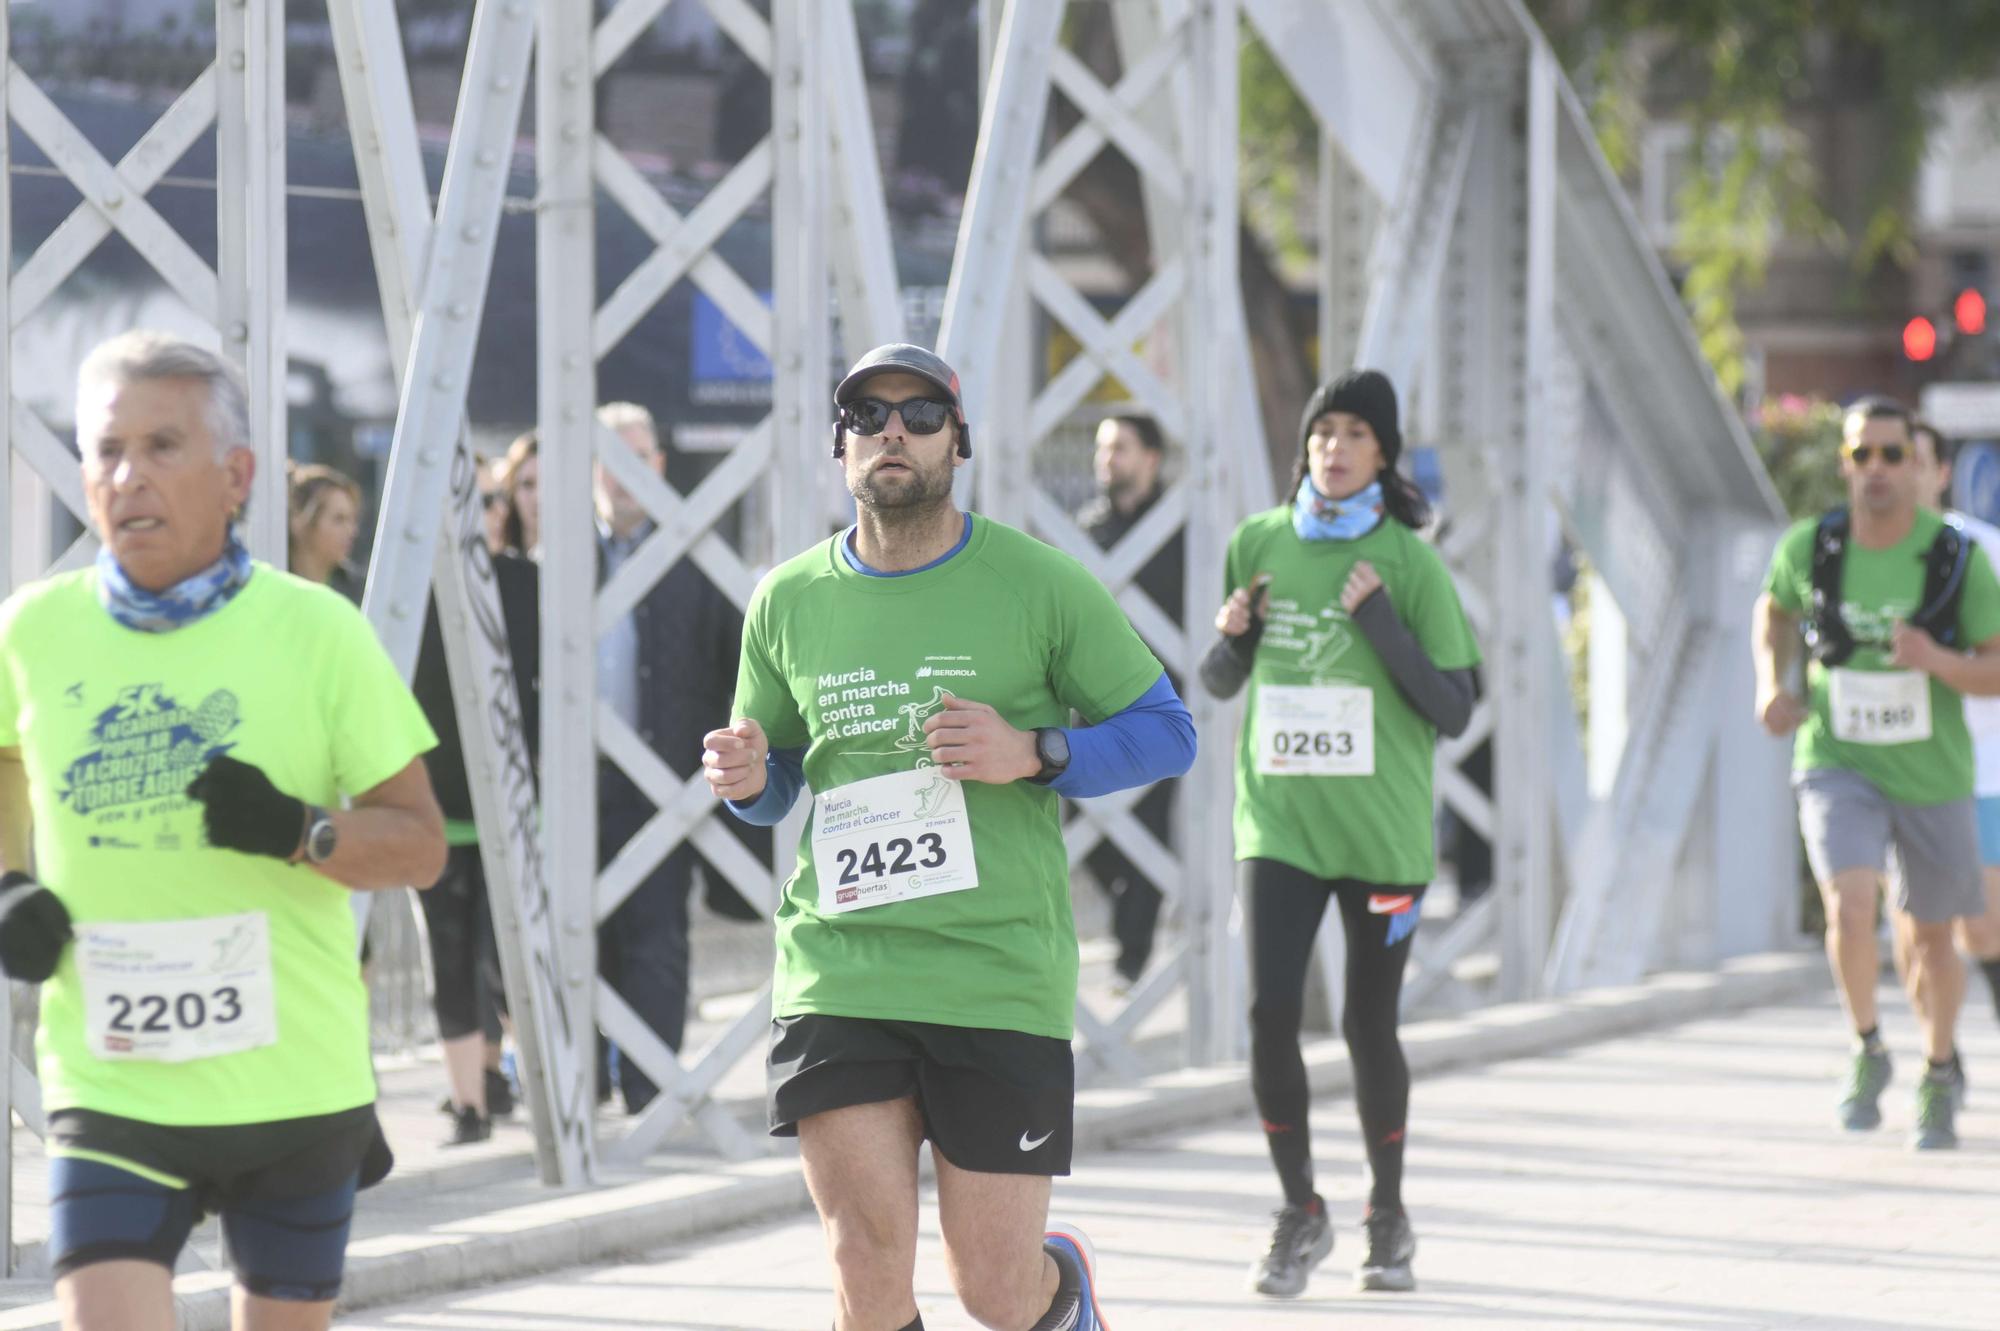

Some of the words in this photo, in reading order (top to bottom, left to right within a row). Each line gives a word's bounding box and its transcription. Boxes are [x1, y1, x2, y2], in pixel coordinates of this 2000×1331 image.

[818, 667, 876, 690] Murcia
[932, 669, 977, 677] IBERDROLA
[117, 684, 162, 719] 5K
[818, 692, 840, 707] en
[842, 680, 910, 703] marcha
[821, 703, 876, 724] contra
[826, 723, 841, 740] el
[842, 717, 900, 737] cáncer
[1274, 732, 1353, 755] 0263
[74, 762, 96, 787] LA
[96, 754, 146, 780] CRUZ
[147, 749, 169, 773] DE
[824, 799, 852, 814] Murcia
[824, 813, 836, 825] en
[837, 804, 869, 821] marcha
[822, 820, 851, 835] contra
[853, 815, 862, 827] el
[863, 809, 902, 825] cáncer
[836, 832, 947, 886] 2423
[107, 986, 242, 1033] 2203
